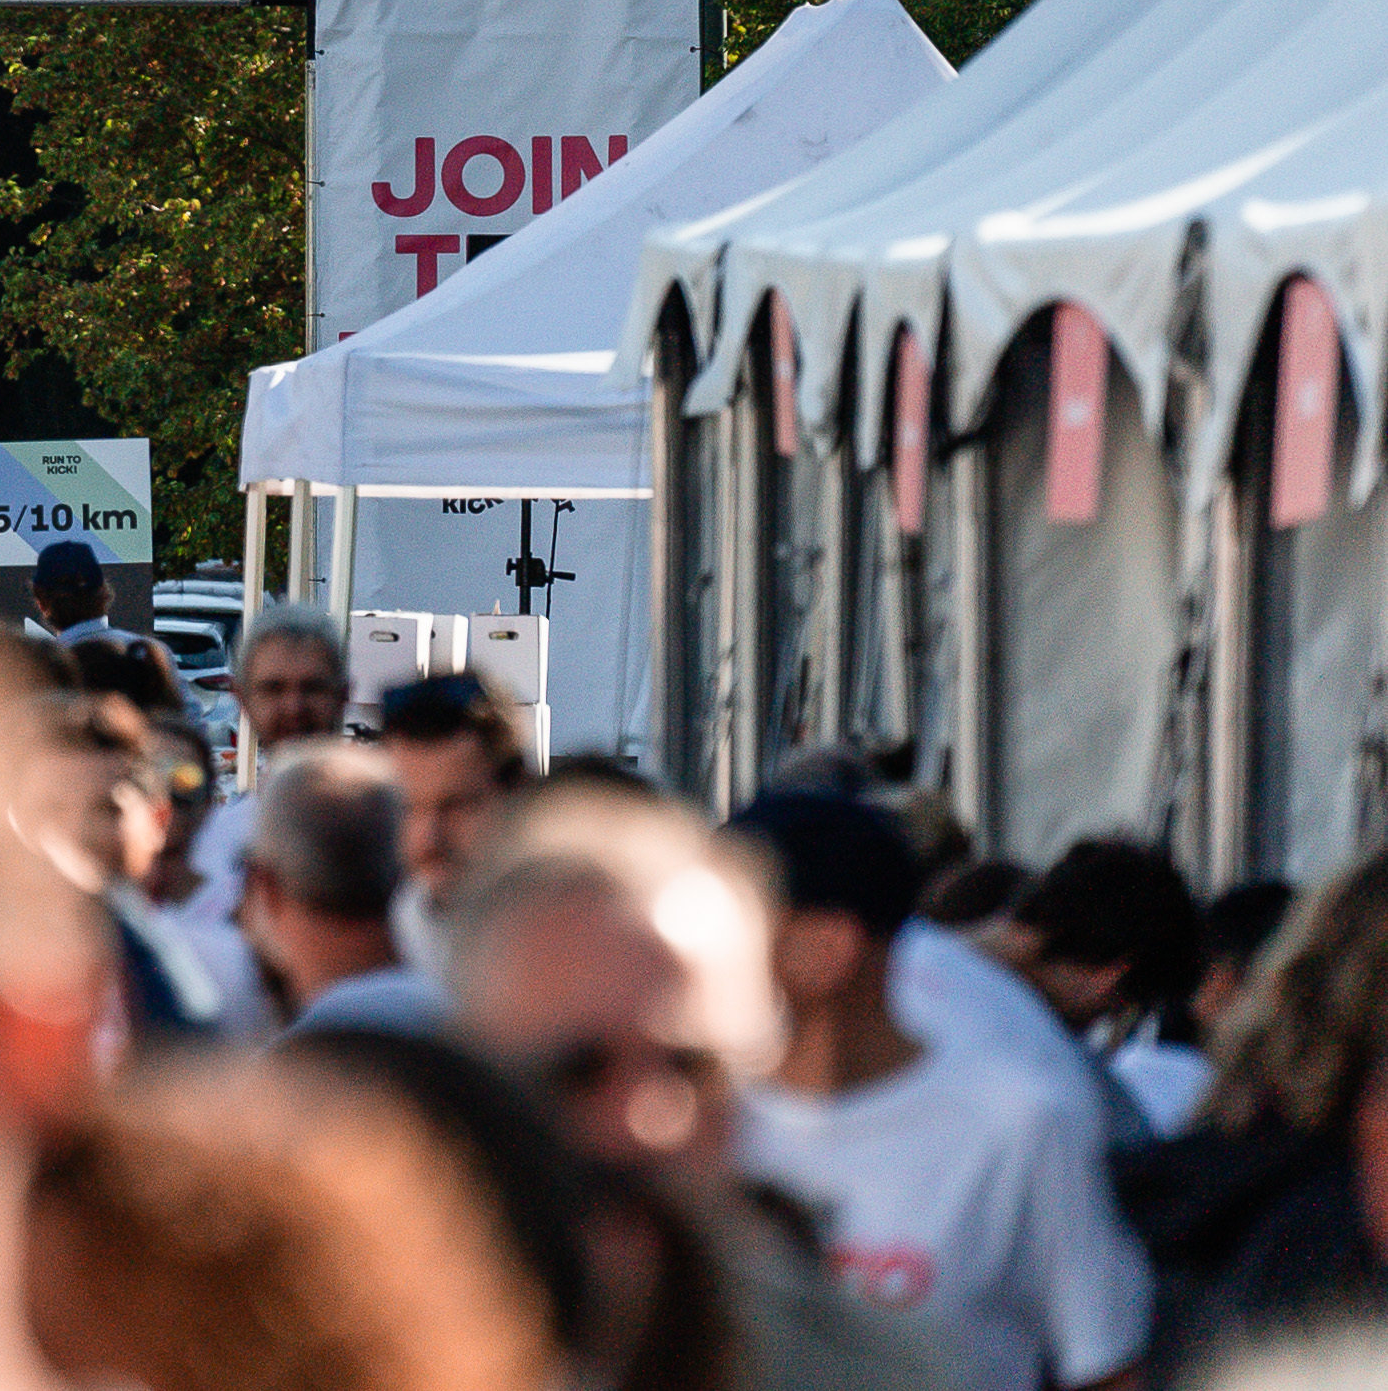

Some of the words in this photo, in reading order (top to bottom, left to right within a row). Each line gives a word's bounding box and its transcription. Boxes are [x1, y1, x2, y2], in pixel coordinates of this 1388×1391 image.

[371, 135, 628, 218] JOIN
[42, 455, 65, 465] RUN
[66, 455, 82, 464] TO
[47, 465, 78, 475] KICK!
[82, 503, 138, 531] km
